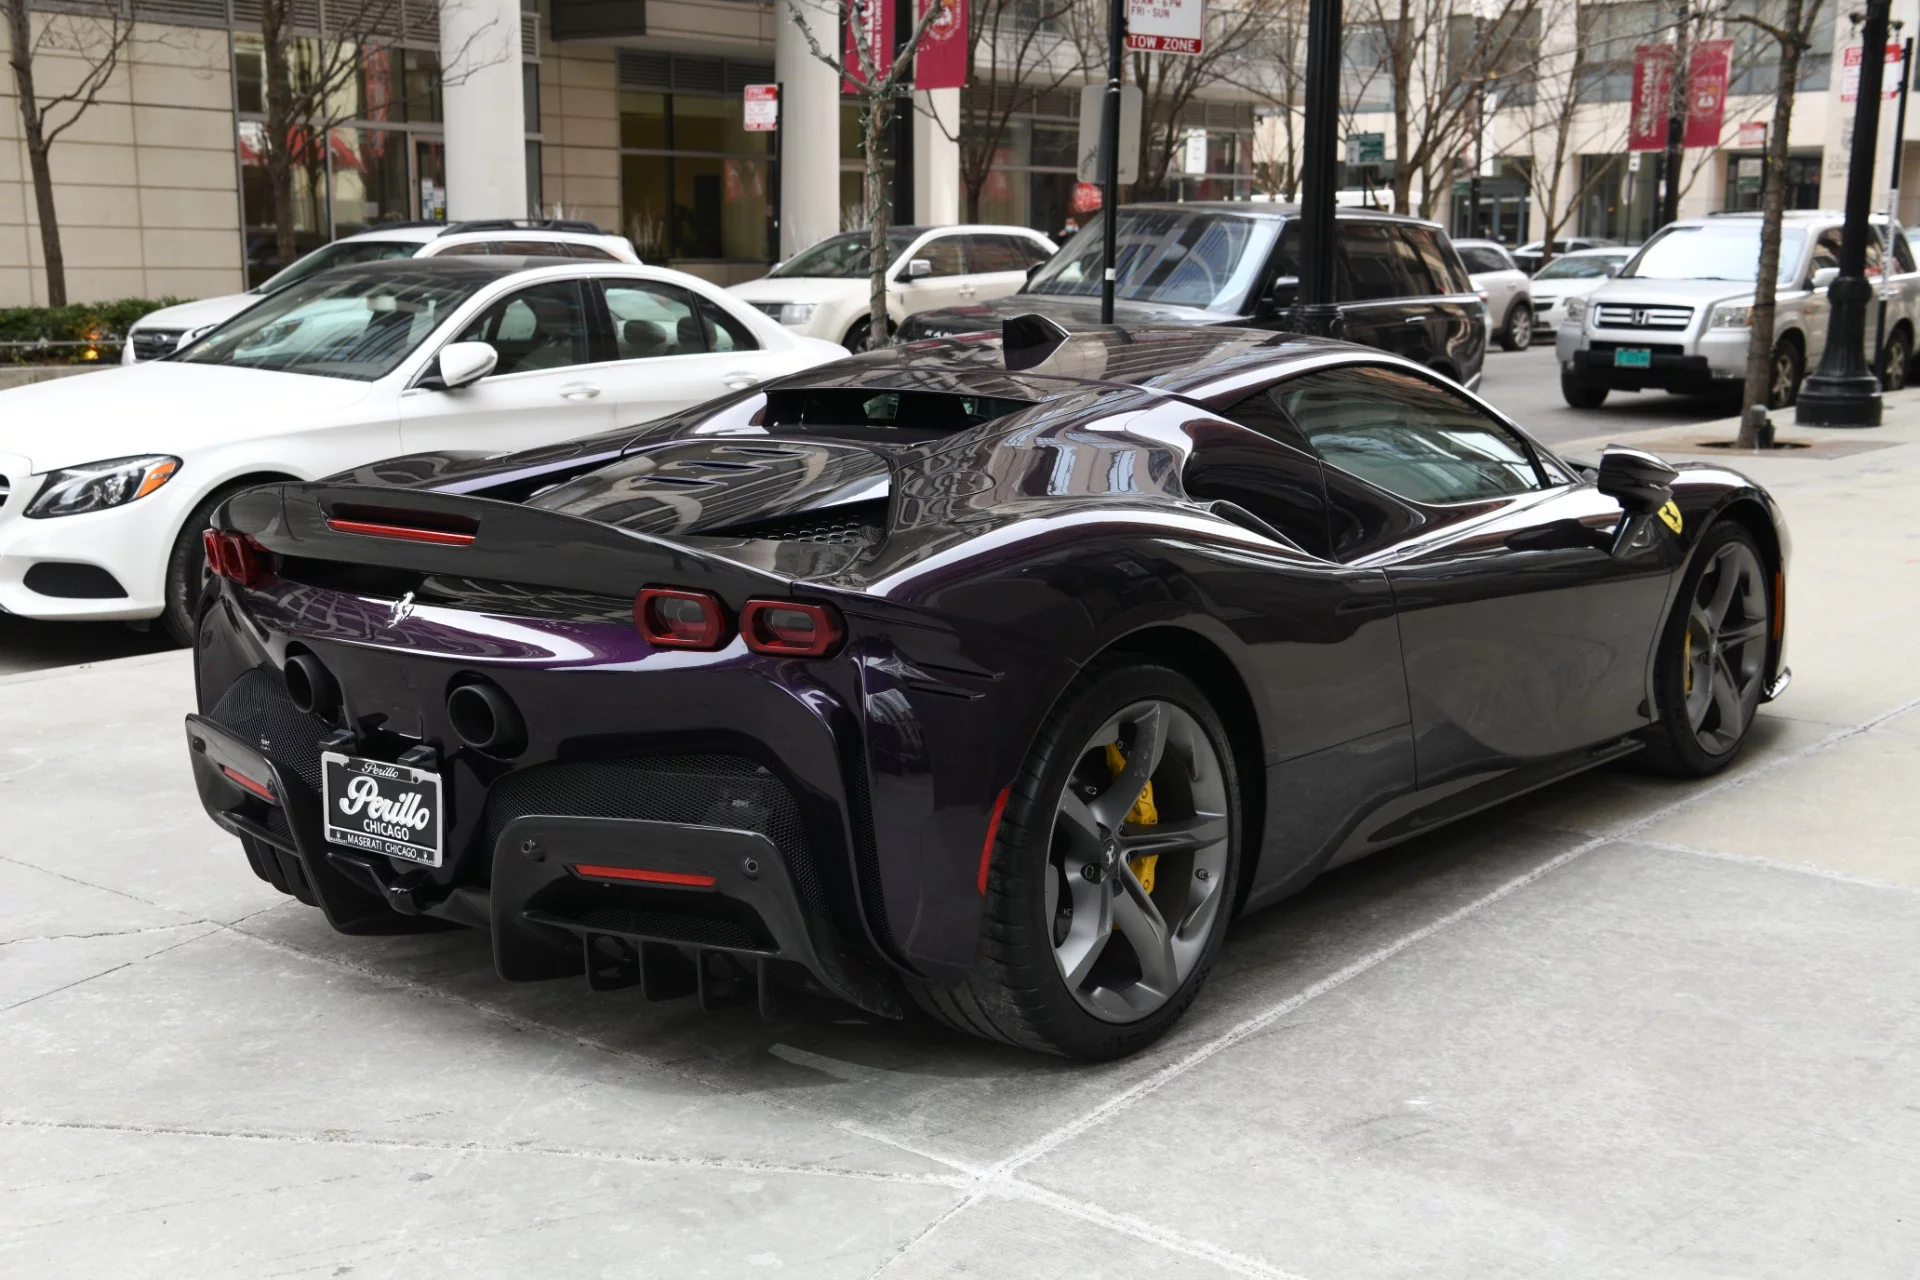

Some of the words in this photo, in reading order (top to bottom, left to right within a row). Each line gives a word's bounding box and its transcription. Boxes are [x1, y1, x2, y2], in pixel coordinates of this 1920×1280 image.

[1131, 5, 1145, 16] FRI
[1152, 7, 1170, 18] SUN
[874, 34, 883, 71] WATER
[1131, 35, 1157, 49] TOW
[1162, 37, 1196, 52] ZONE
[1639, 59, 1655, 137] WELCOME
[361, 762, 399, 778] Perillo
[338, 775, 430, 831] Perillo
[363, 819, 410, 841] CHICAGO
[347, 834, 382, 851] MASERATI
[385, 842, 417, 859] CHICAGO
